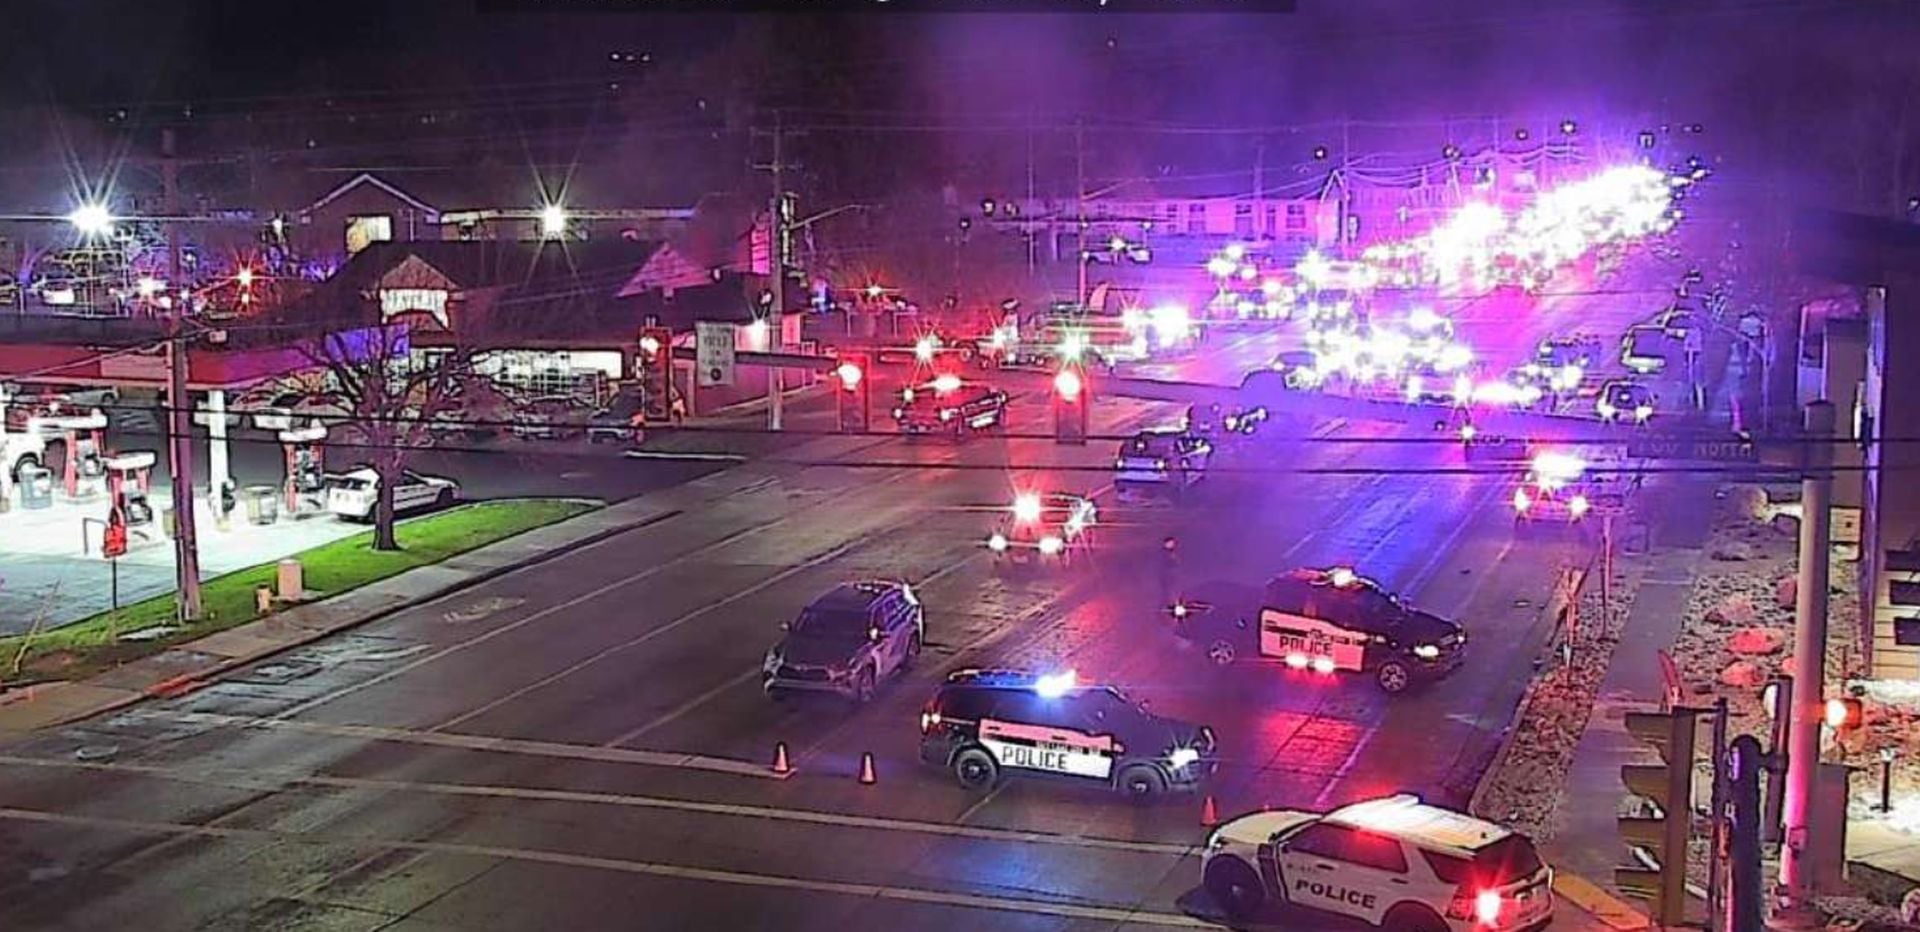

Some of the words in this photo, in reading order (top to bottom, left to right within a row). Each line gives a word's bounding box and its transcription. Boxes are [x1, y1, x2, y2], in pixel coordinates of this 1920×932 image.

[1280, 636, 1333, 656] POLICE
[1002, 746, 1067, 769] POLICE
[1295, 879, 1376, 909] POLICE
